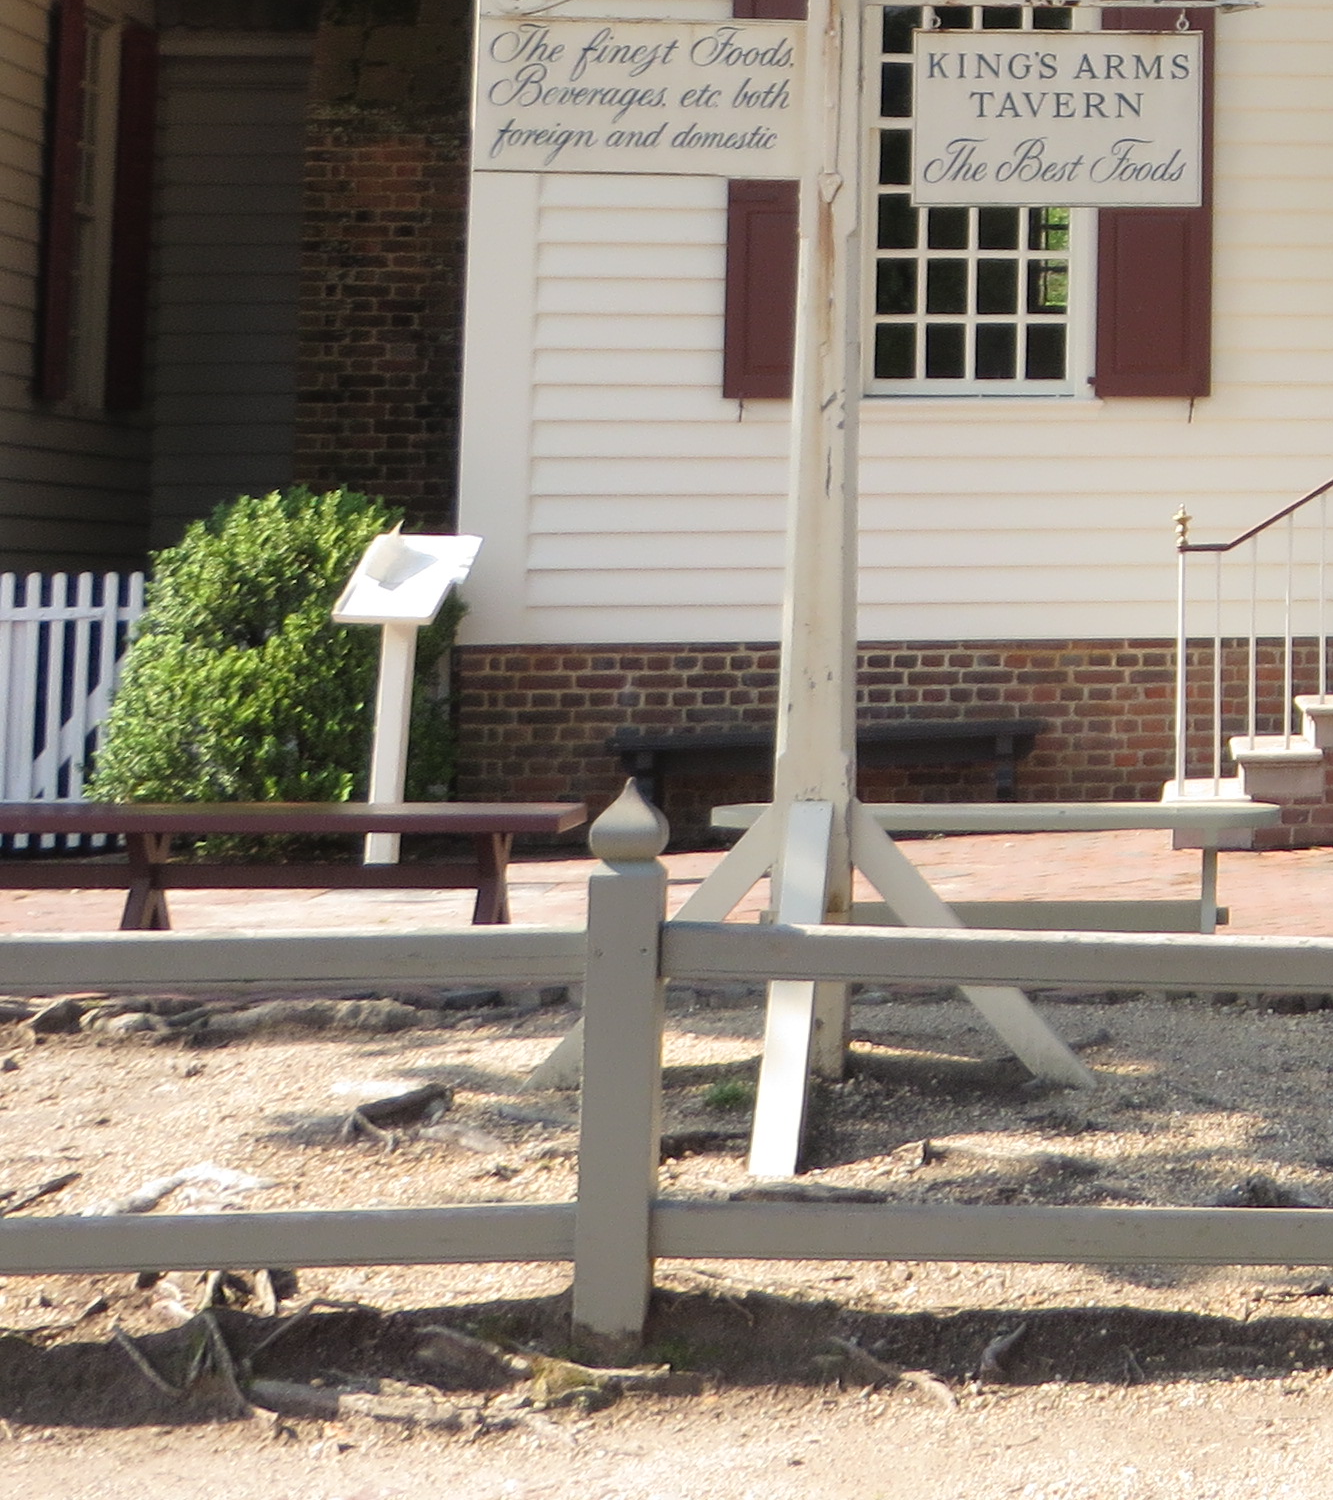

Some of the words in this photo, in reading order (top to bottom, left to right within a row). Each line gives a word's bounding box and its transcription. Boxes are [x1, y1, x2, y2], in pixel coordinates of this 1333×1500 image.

[490, 23, 565, 63] The
[571, 27, 679, 81] finest
[927, 51, 1058, 80] KING'S
[1073, 53, 1190, 80] ARMS
[731, 77, 790, 109] both
[969, 91, 1144, 118] TAVERN
[490, 118, 597, 166] foreign
[605, 122, 669, 148] and
[671, 122, 779, 150] domestic
[923, 138, 989, 184] The
[995, 136, 1086, 182] Best
[1090, 138, 1187, 183] Foods
